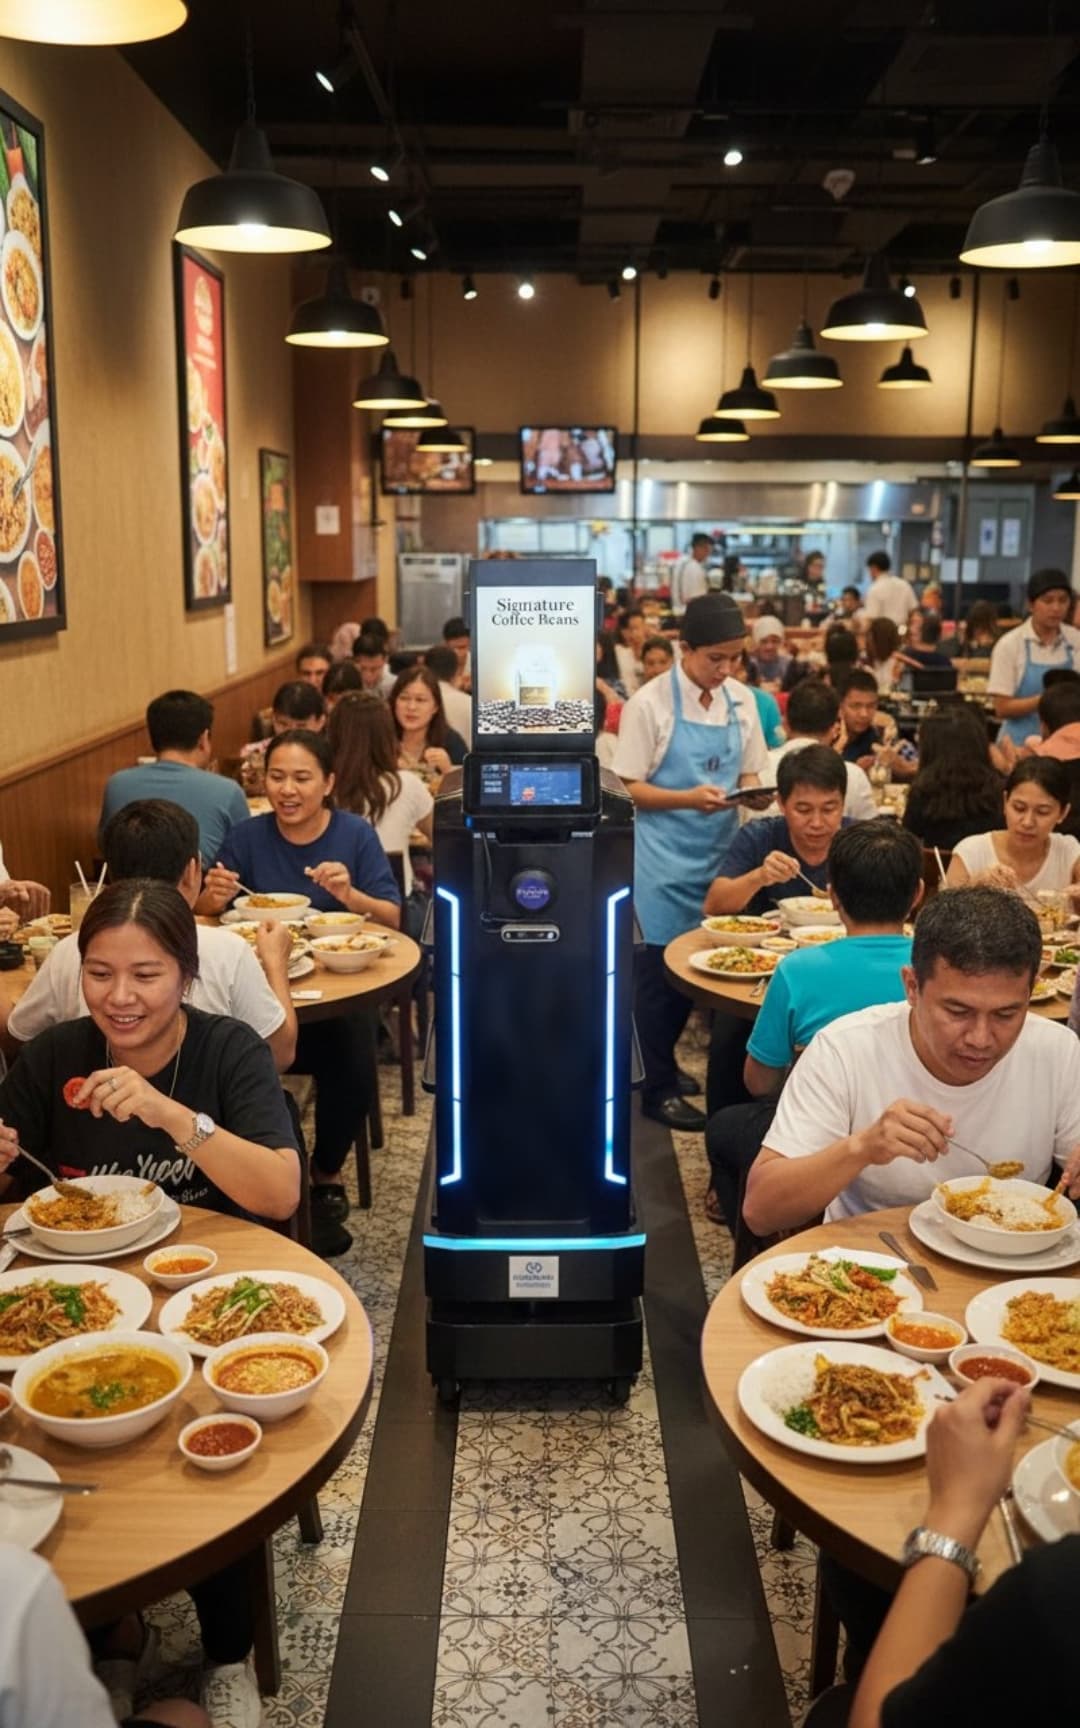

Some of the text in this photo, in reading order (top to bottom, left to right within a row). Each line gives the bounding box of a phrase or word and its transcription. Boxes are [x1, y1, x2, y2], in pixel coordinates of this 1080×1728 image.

[496, 598, 575, 614] Signature
[492, 613, 580, 626] Coffee Beans
